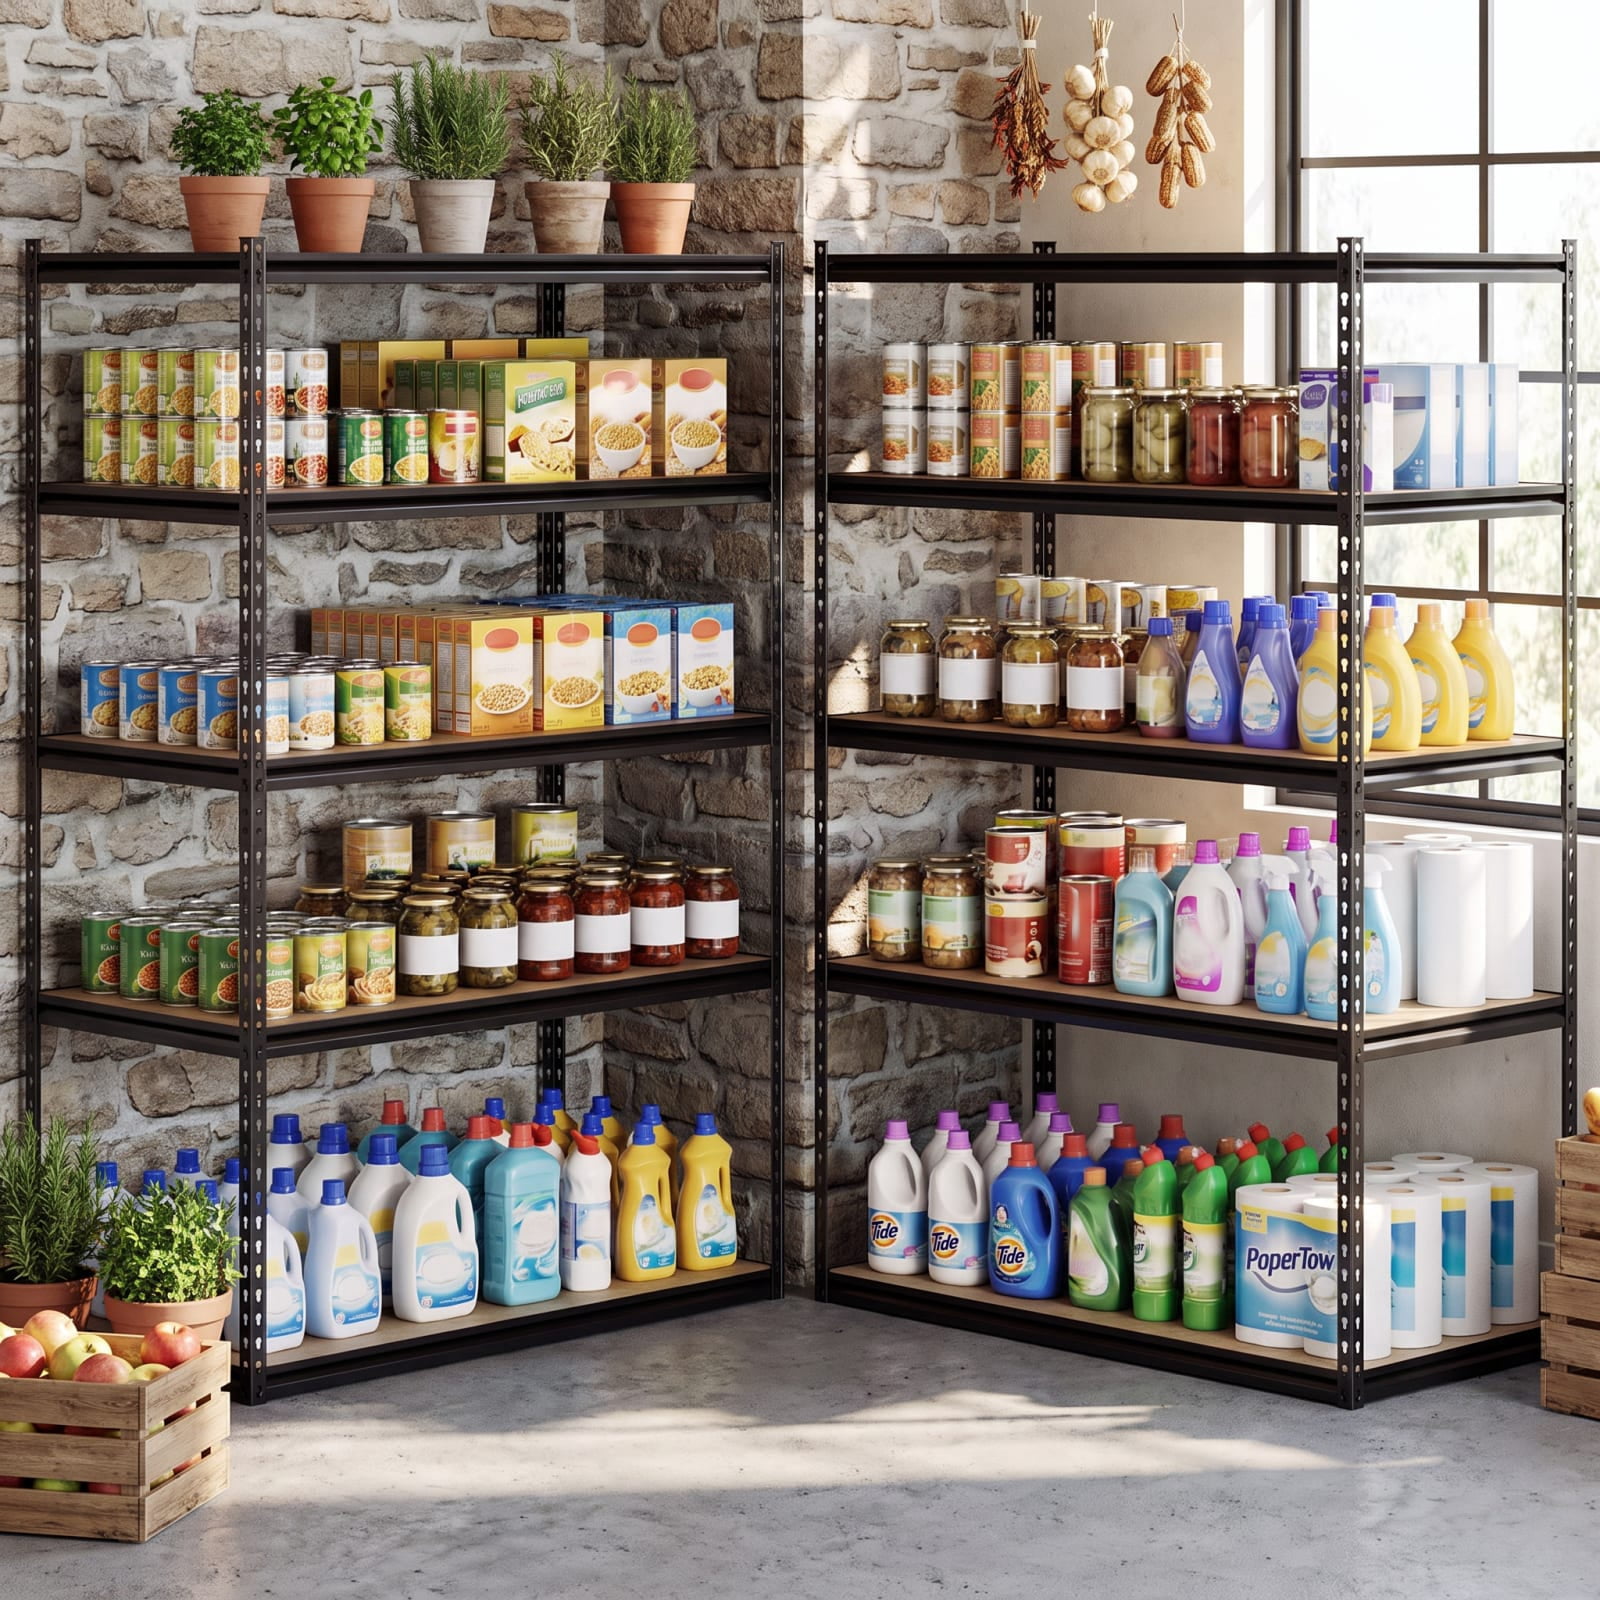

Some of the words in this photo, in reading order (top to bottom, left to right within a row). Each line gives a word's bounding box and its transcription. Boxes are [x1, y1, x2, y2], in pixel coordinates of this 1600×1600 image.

[871, 1220, 898, 1241] Tide
[931, 1231, 959, 1252] Tide
[997, 1245, 1025, 1266] Tide
[1246, 1246, 1335, 1276] PoperTow
